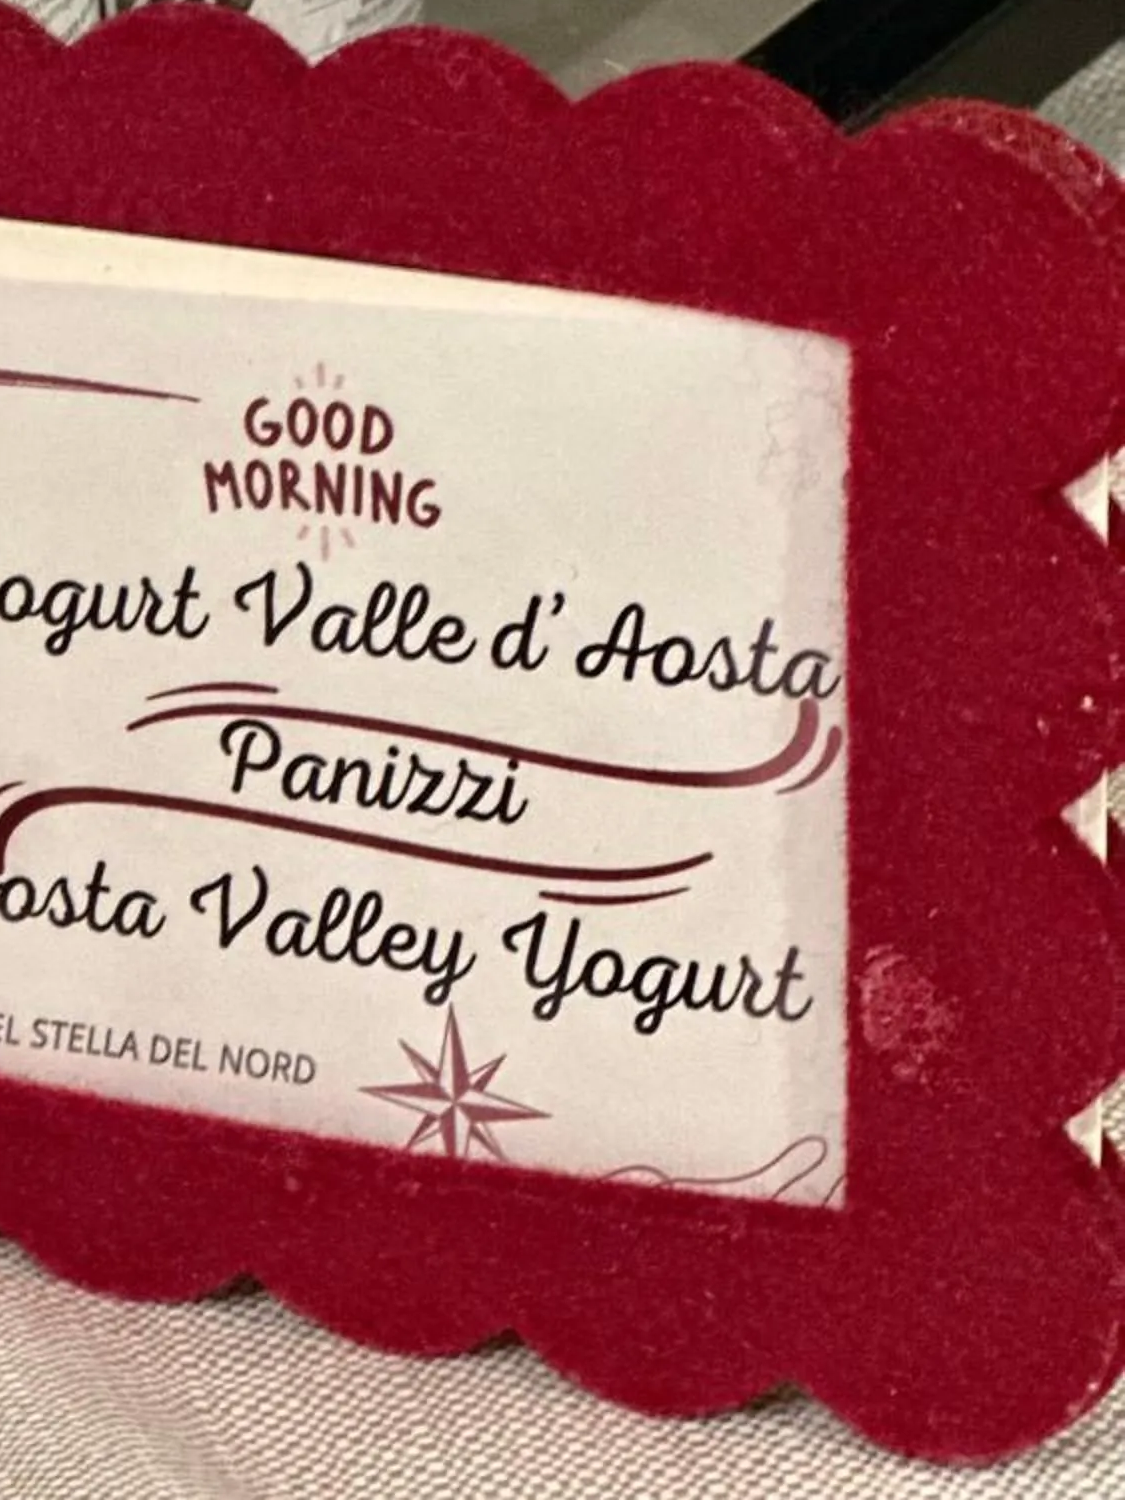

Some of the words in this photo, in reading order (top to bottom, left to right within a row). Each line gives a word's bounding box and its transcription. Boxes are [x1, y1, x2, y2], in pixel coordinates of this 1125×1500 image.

[243, 396, 395, 456] GOOD
[203, 458, 442, 529] MORNING
[233, 560, 478, 666] Valle
[218, 717, 530, 826] Panizzi
[189, 864, 478, 1007] Valley
[501, 910, 814, 1036] Yogurt
[29, 1017, 140, 1062] STELLA
[148, 1033, 208, 1072] DEL
[218, 1043, 317, 1087] NORD
